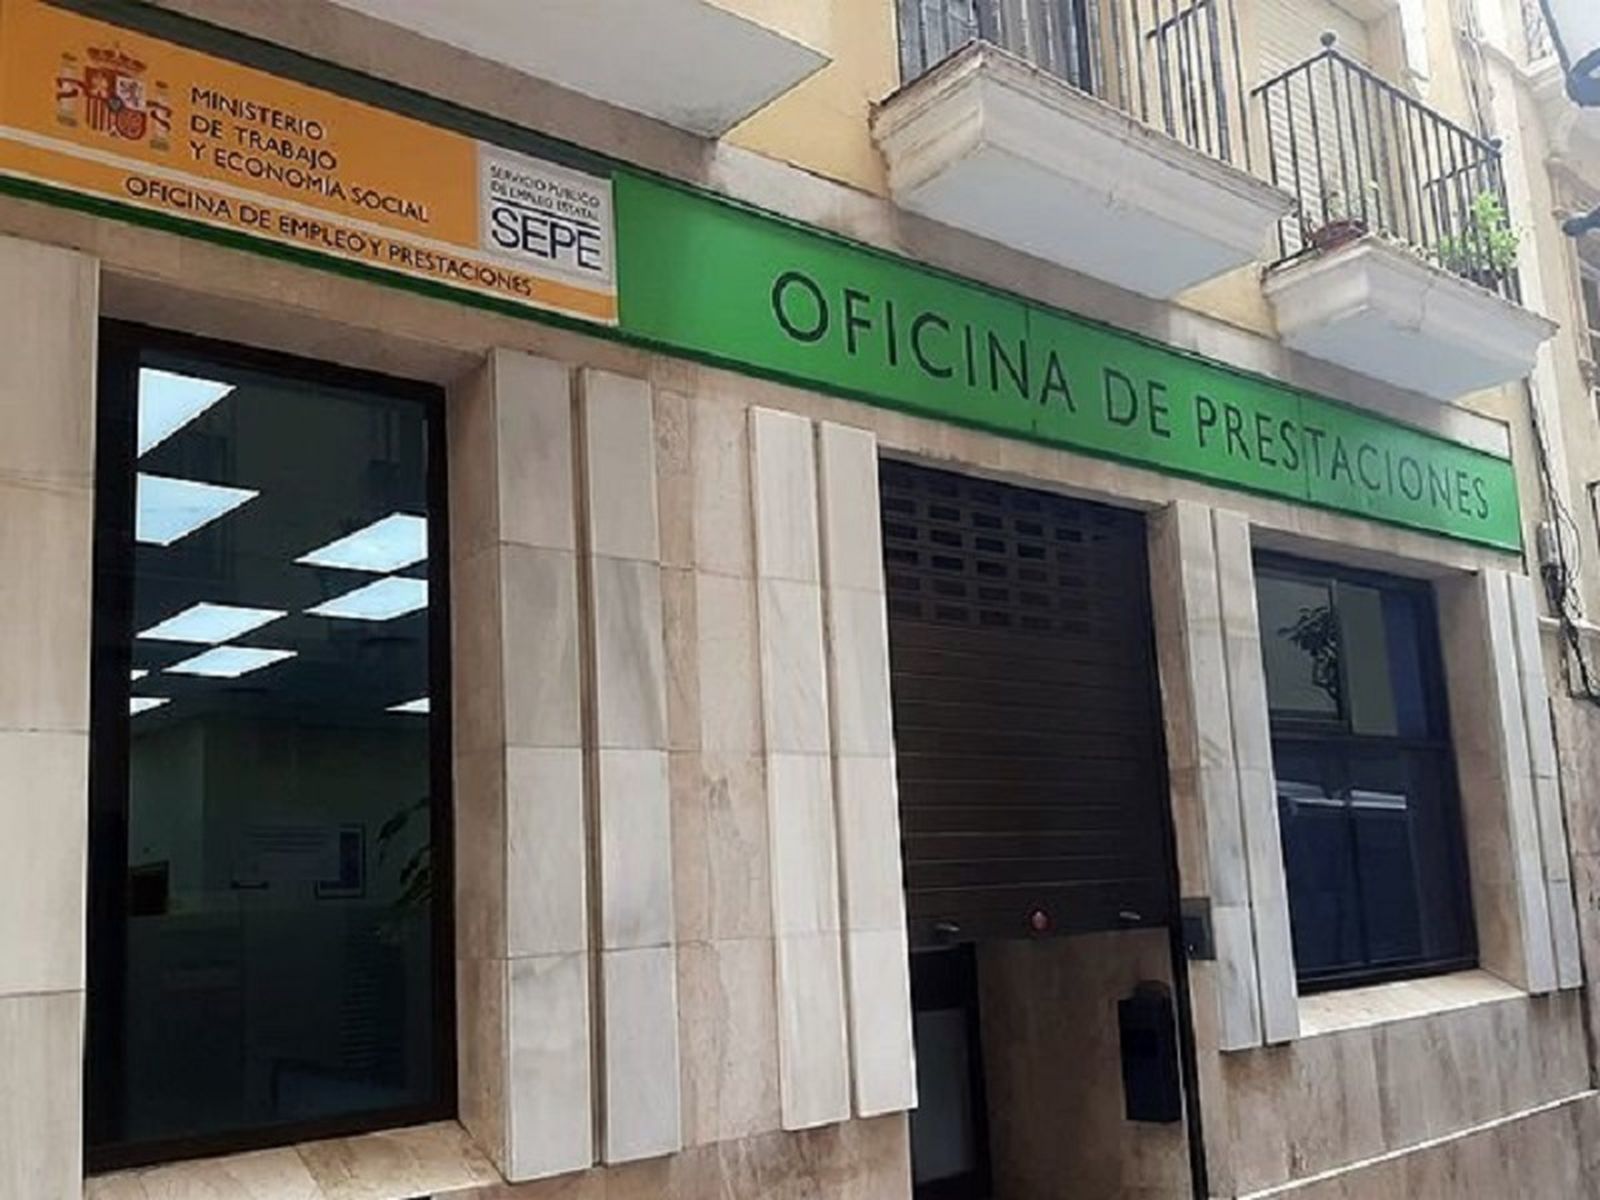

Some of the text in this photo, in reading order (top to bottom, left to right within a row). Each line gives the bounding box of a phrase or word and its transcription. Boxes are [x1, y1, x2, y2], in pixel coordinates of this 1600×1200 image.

[190, 115, 337, 171] DE TRABAJO
[191, 87, 323, 141] MINISTERIO
[190, 140, 430, 223] Y ECONOMÍA SOCIAL
[125, 176, 232, 220] OFICINA
[239, 205, 271, 230] DE
[279, 215, 366, 254] EMPLEO
[388, 244, 532, 297] PRESTACIONES
[491, 207, 602, 271] SEPE
[772, 271, 1490, 520] OFICINA DE PRESTACIONES
